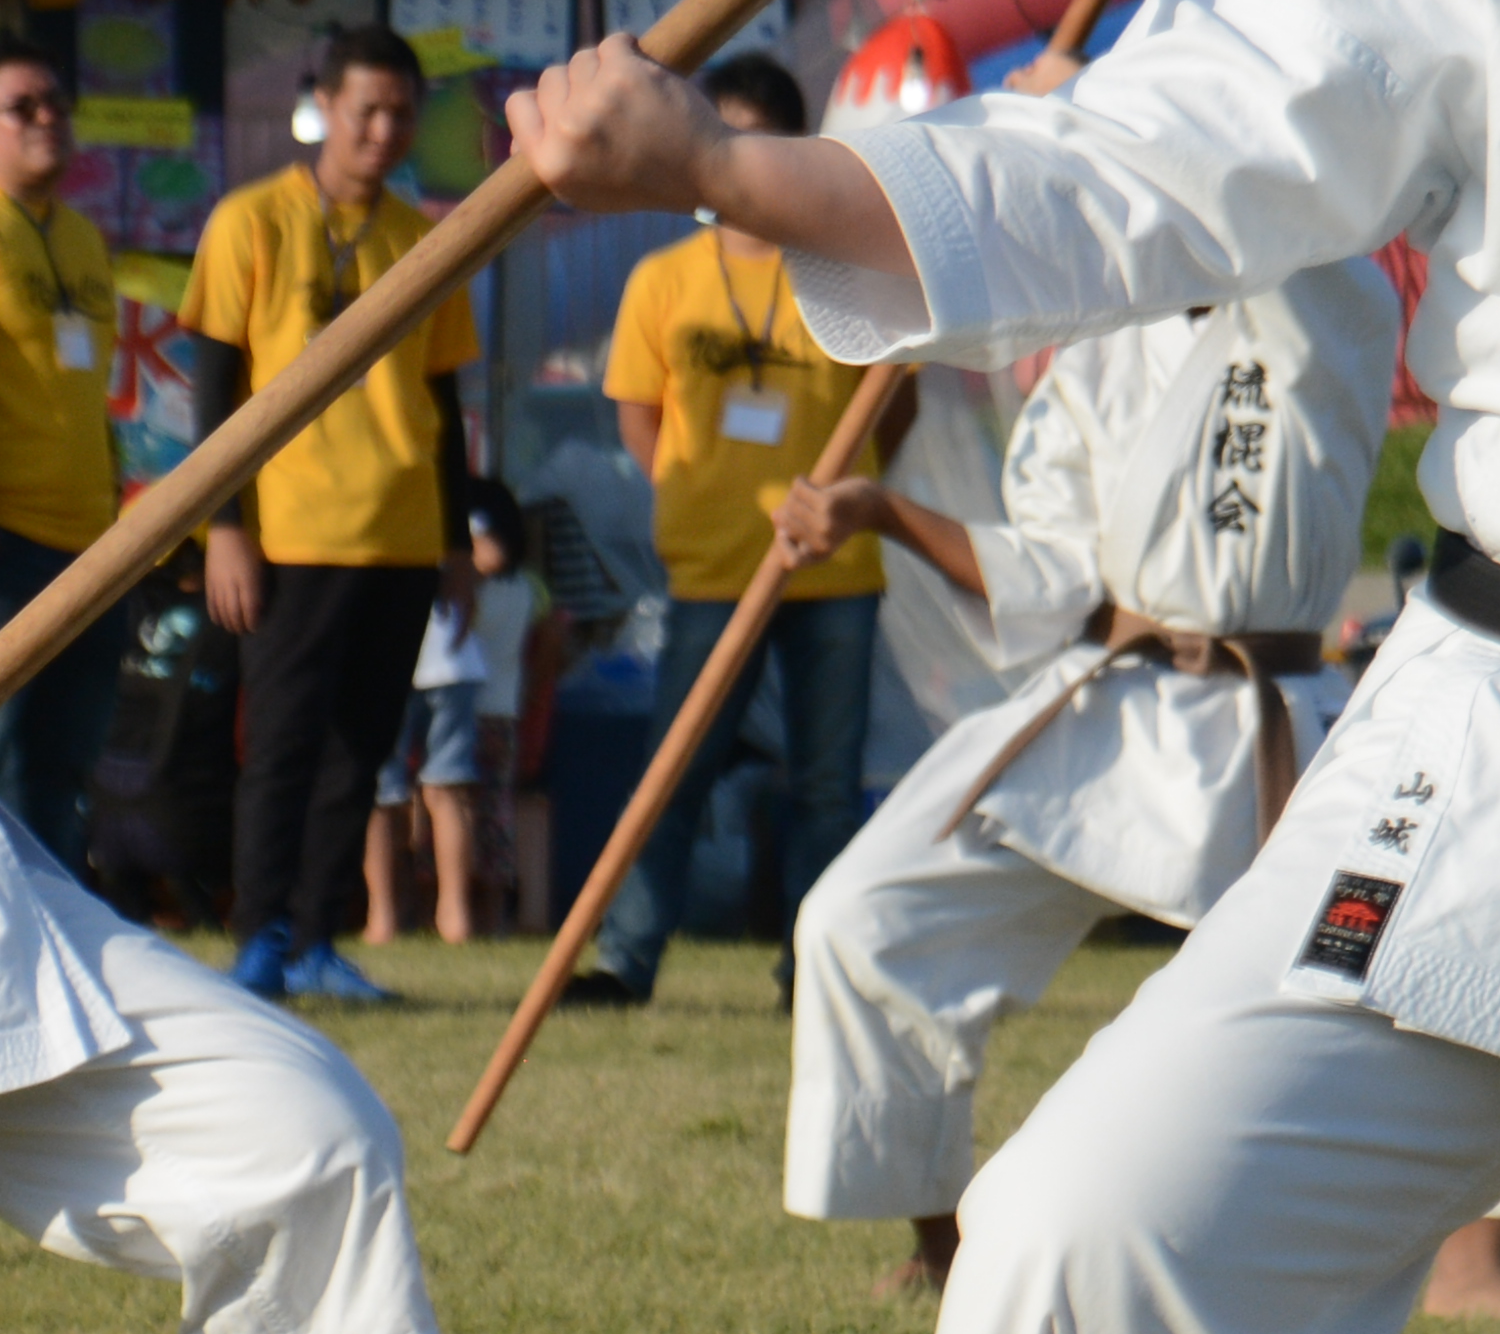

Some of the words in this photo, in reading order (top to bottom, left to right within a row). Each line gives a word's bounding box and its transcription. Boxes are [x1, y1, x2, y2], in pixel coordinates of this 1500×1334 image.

[1208, 361, 1273, 537] 琉棍会
[1369, 771, 1435, 857] 山城
